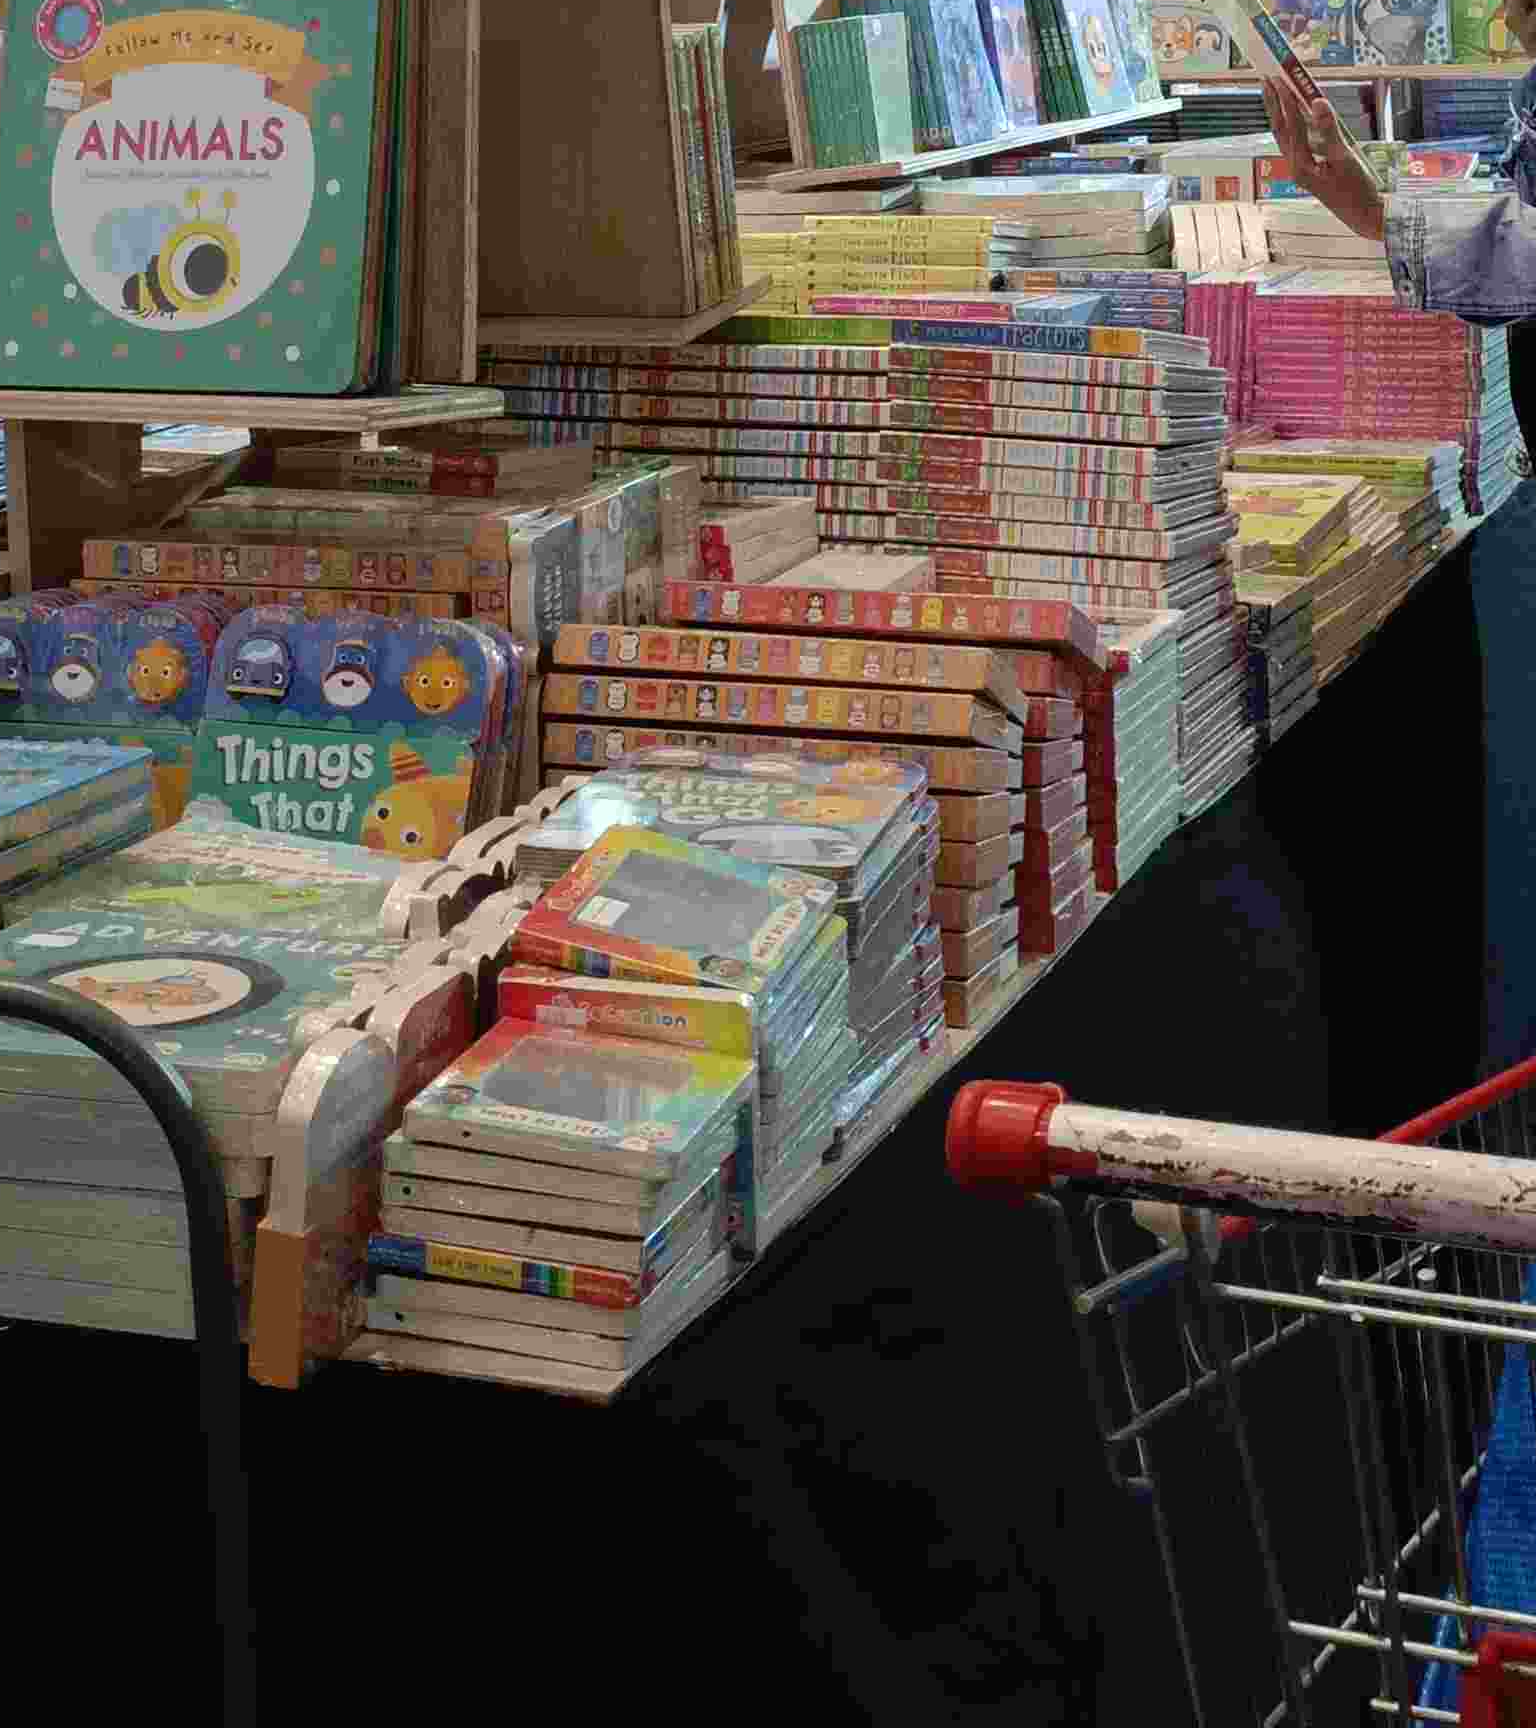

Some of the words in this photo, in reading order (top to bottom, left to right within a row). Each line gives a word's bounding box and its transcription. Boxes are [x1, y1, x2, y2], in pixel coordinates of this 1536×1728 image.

[75, 114, 286, 163] ANIMALS
[1002, 324, 1088, 352] Tractors
[216, 732, 376, 789] Things
[249, 791, 355, 835] That
